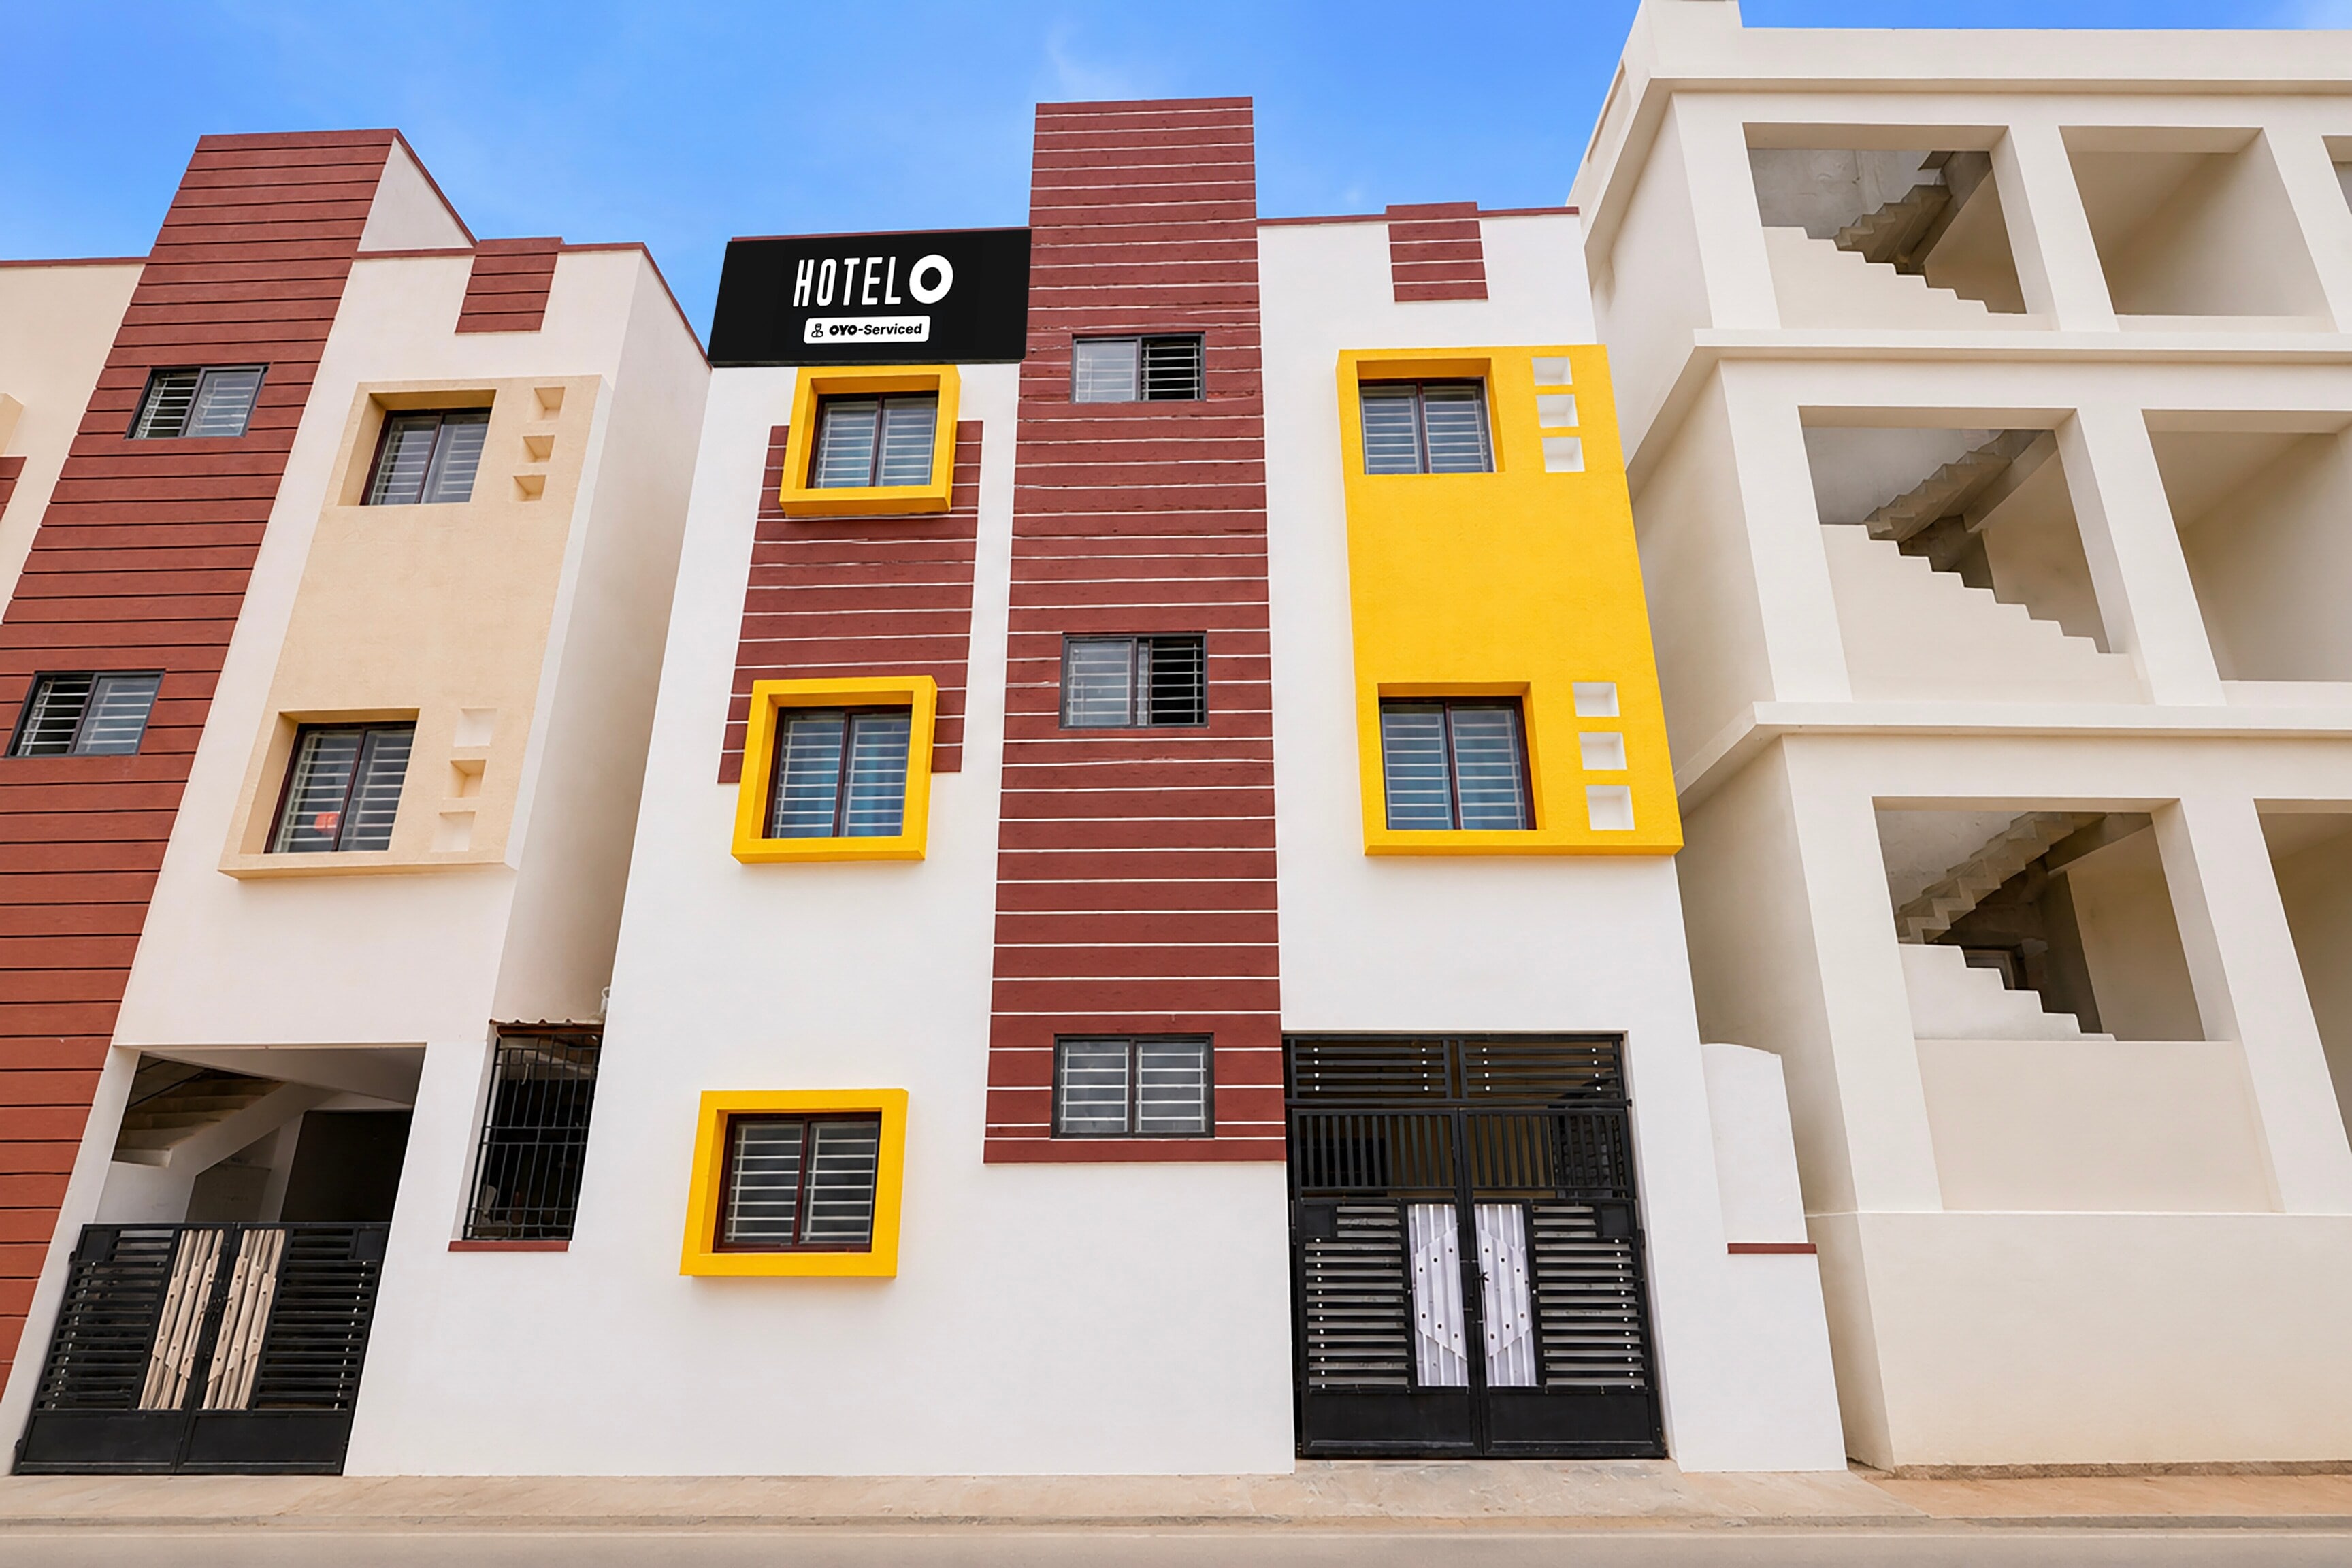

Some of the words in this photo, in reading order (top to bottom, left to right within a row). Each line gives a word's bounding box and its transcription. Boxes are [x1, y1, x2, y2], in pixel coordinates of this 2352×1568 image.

[793, 256, 901, 306] HOTEL
[909, 254, 953, 304] O
[828, 323, 922, 336] OYO-Serviced
